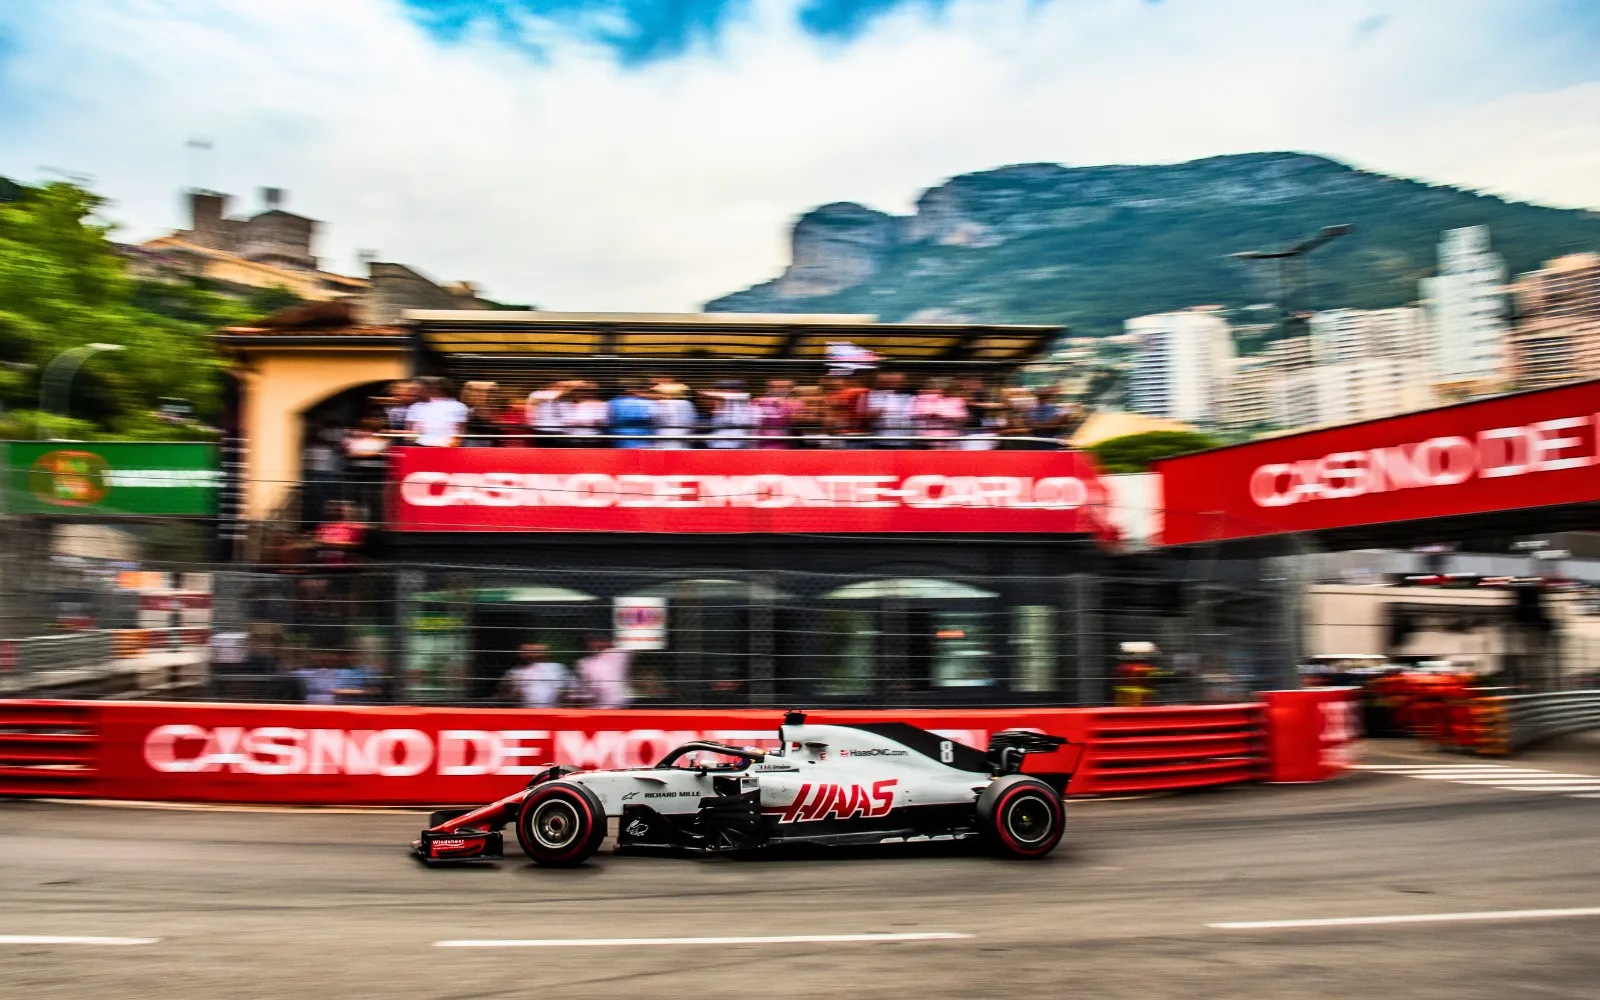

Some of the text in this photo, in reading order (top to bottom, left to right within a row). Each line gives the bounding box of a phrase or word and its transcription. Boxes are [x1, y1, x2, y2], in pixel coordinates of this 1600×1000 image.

[1250, 435, 1477, 507] CASINO
[1477, 415, 1591, 478] DE
[400, 471, 1089, 510] CASINO DE MONTE-CARLO
[143, 723, 437, 777] CASINO
[435, 729, 553, 776] DE
[850, 749, 908, 757] HaasCNC.com
[939, 740, 954, 763] 8
[778, 778, 898, 824] HAAS
